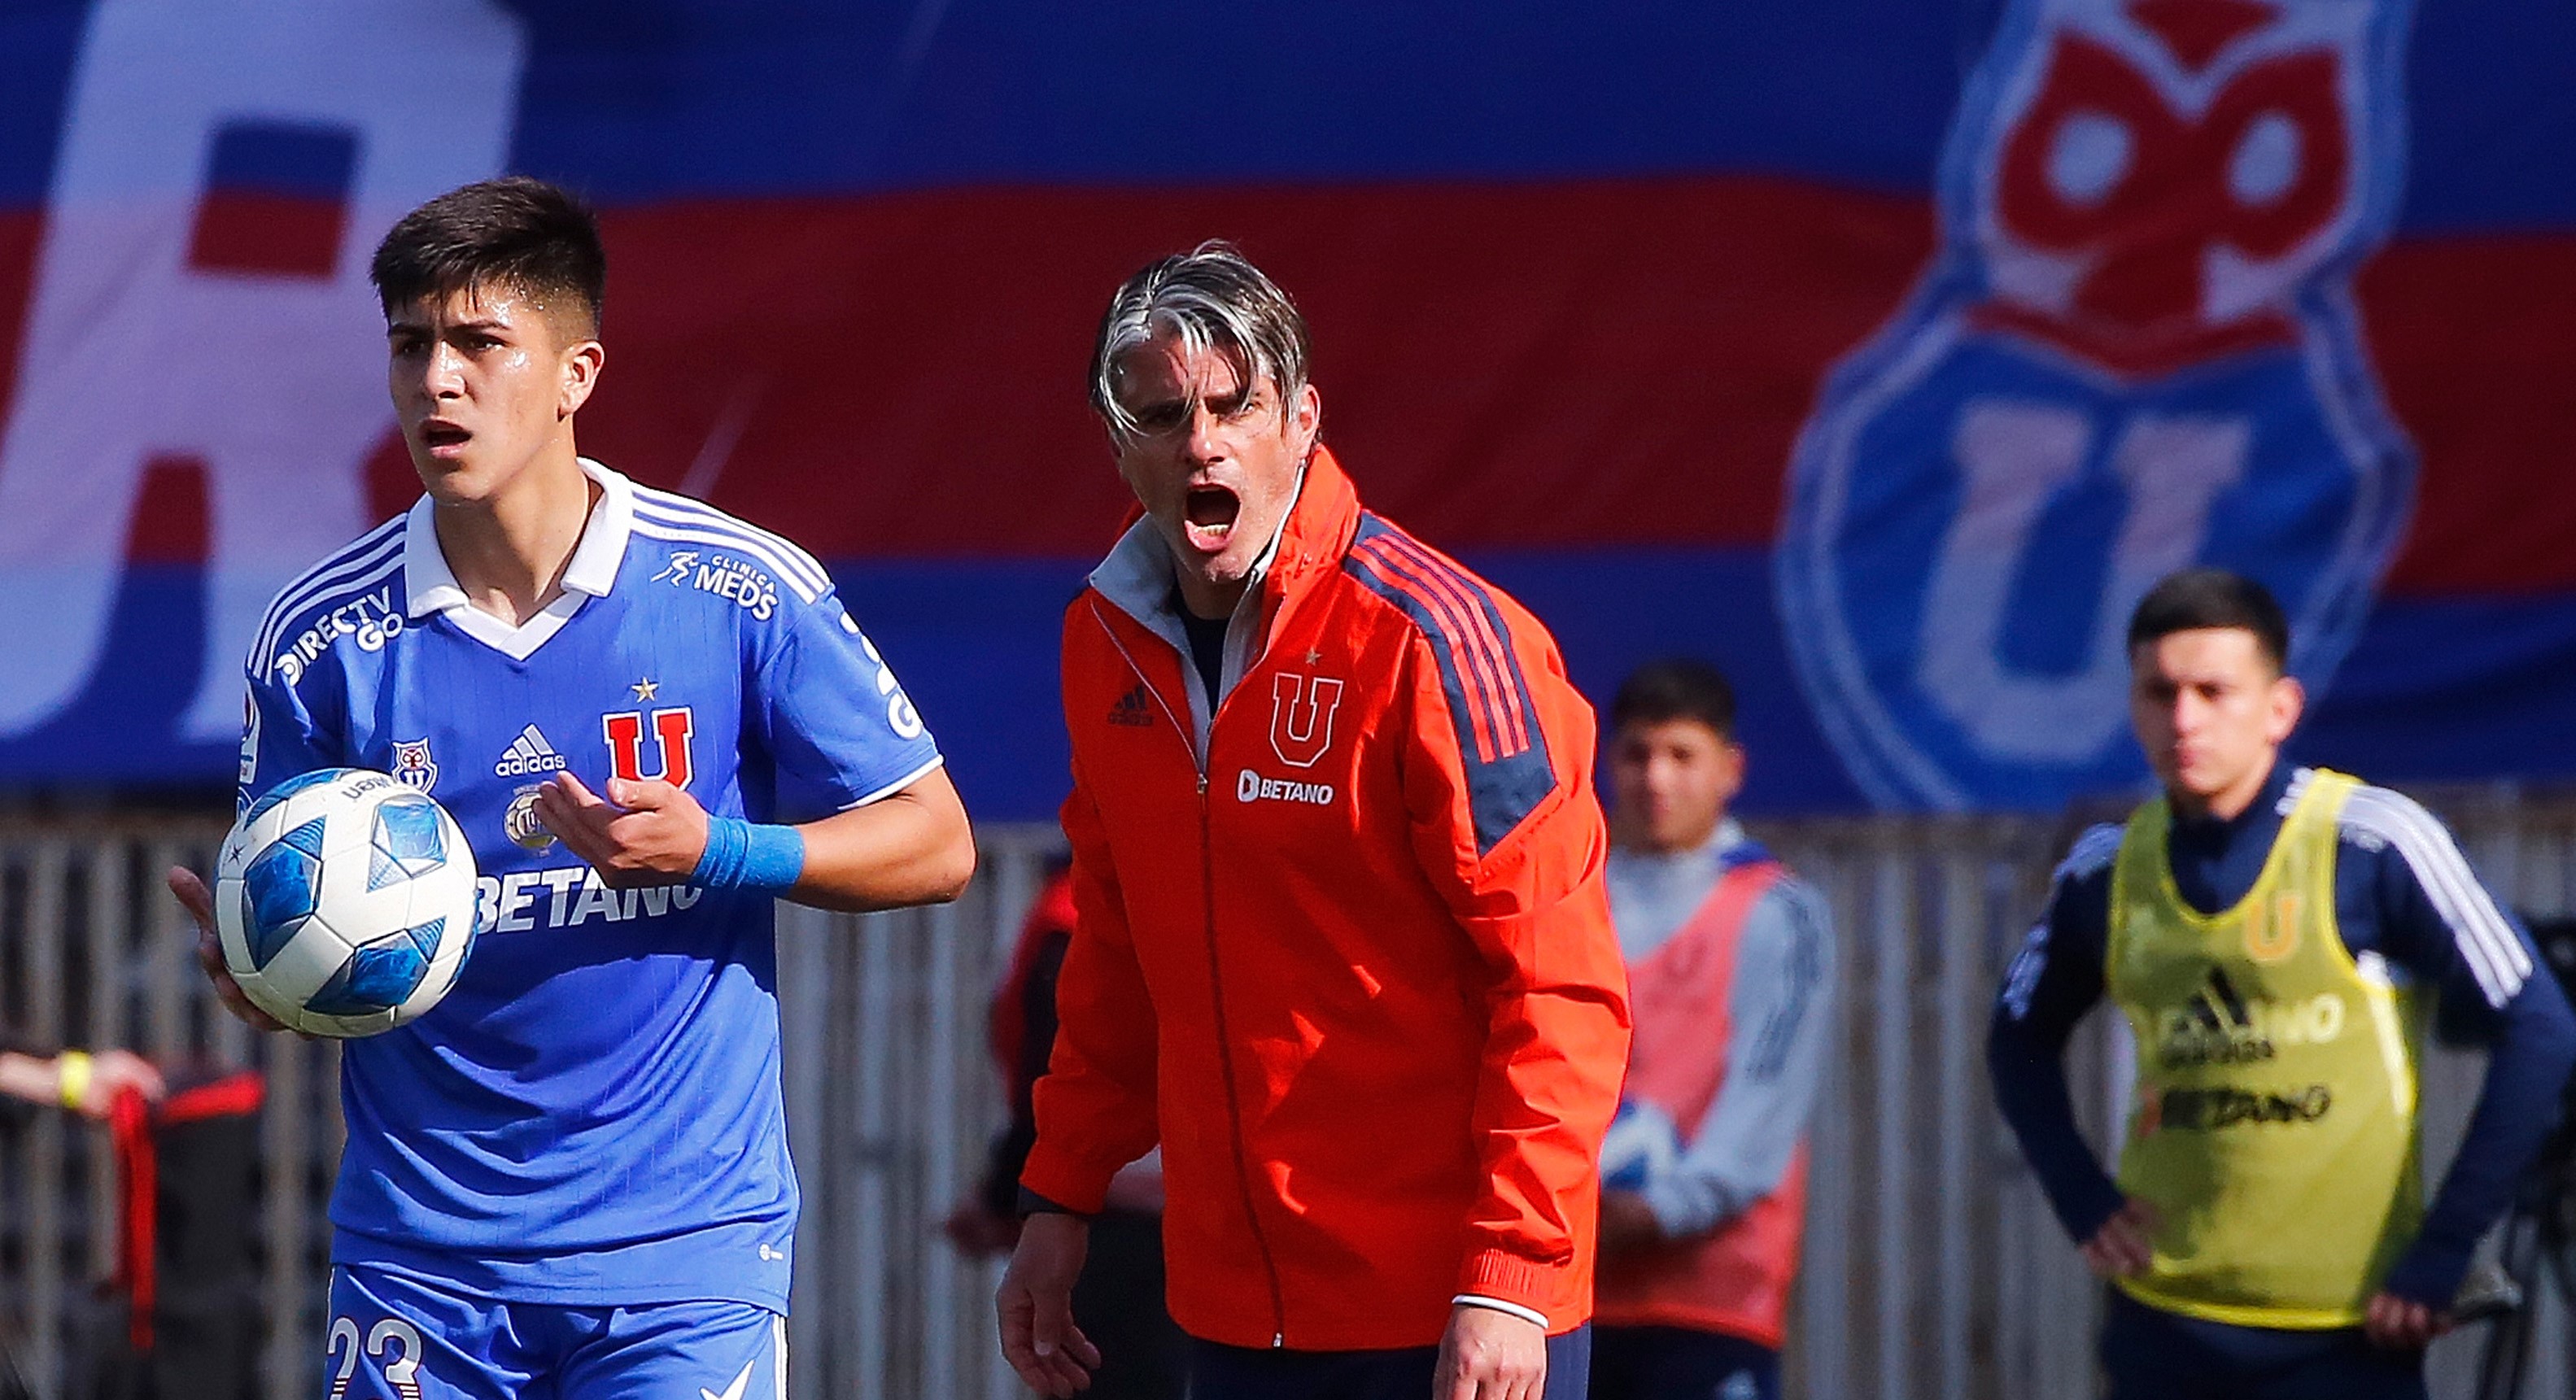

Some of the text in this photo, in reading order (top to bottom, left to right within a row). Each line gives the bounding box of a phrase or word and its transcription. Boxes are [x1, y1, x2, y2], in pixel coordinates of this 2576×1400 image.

[693, 564, 779, 621] MEDS
[274, 585, 392, 687] DIRECTV
[356, 613, 404, 652] GO
[602, 707, 696, 792] U
[1269, 672, 1344, 768] U
[495, 754, 567, 777] adidas
[1260, 778, 1334, 805] BETANO
[326, 1317, 423, 1400] 23
